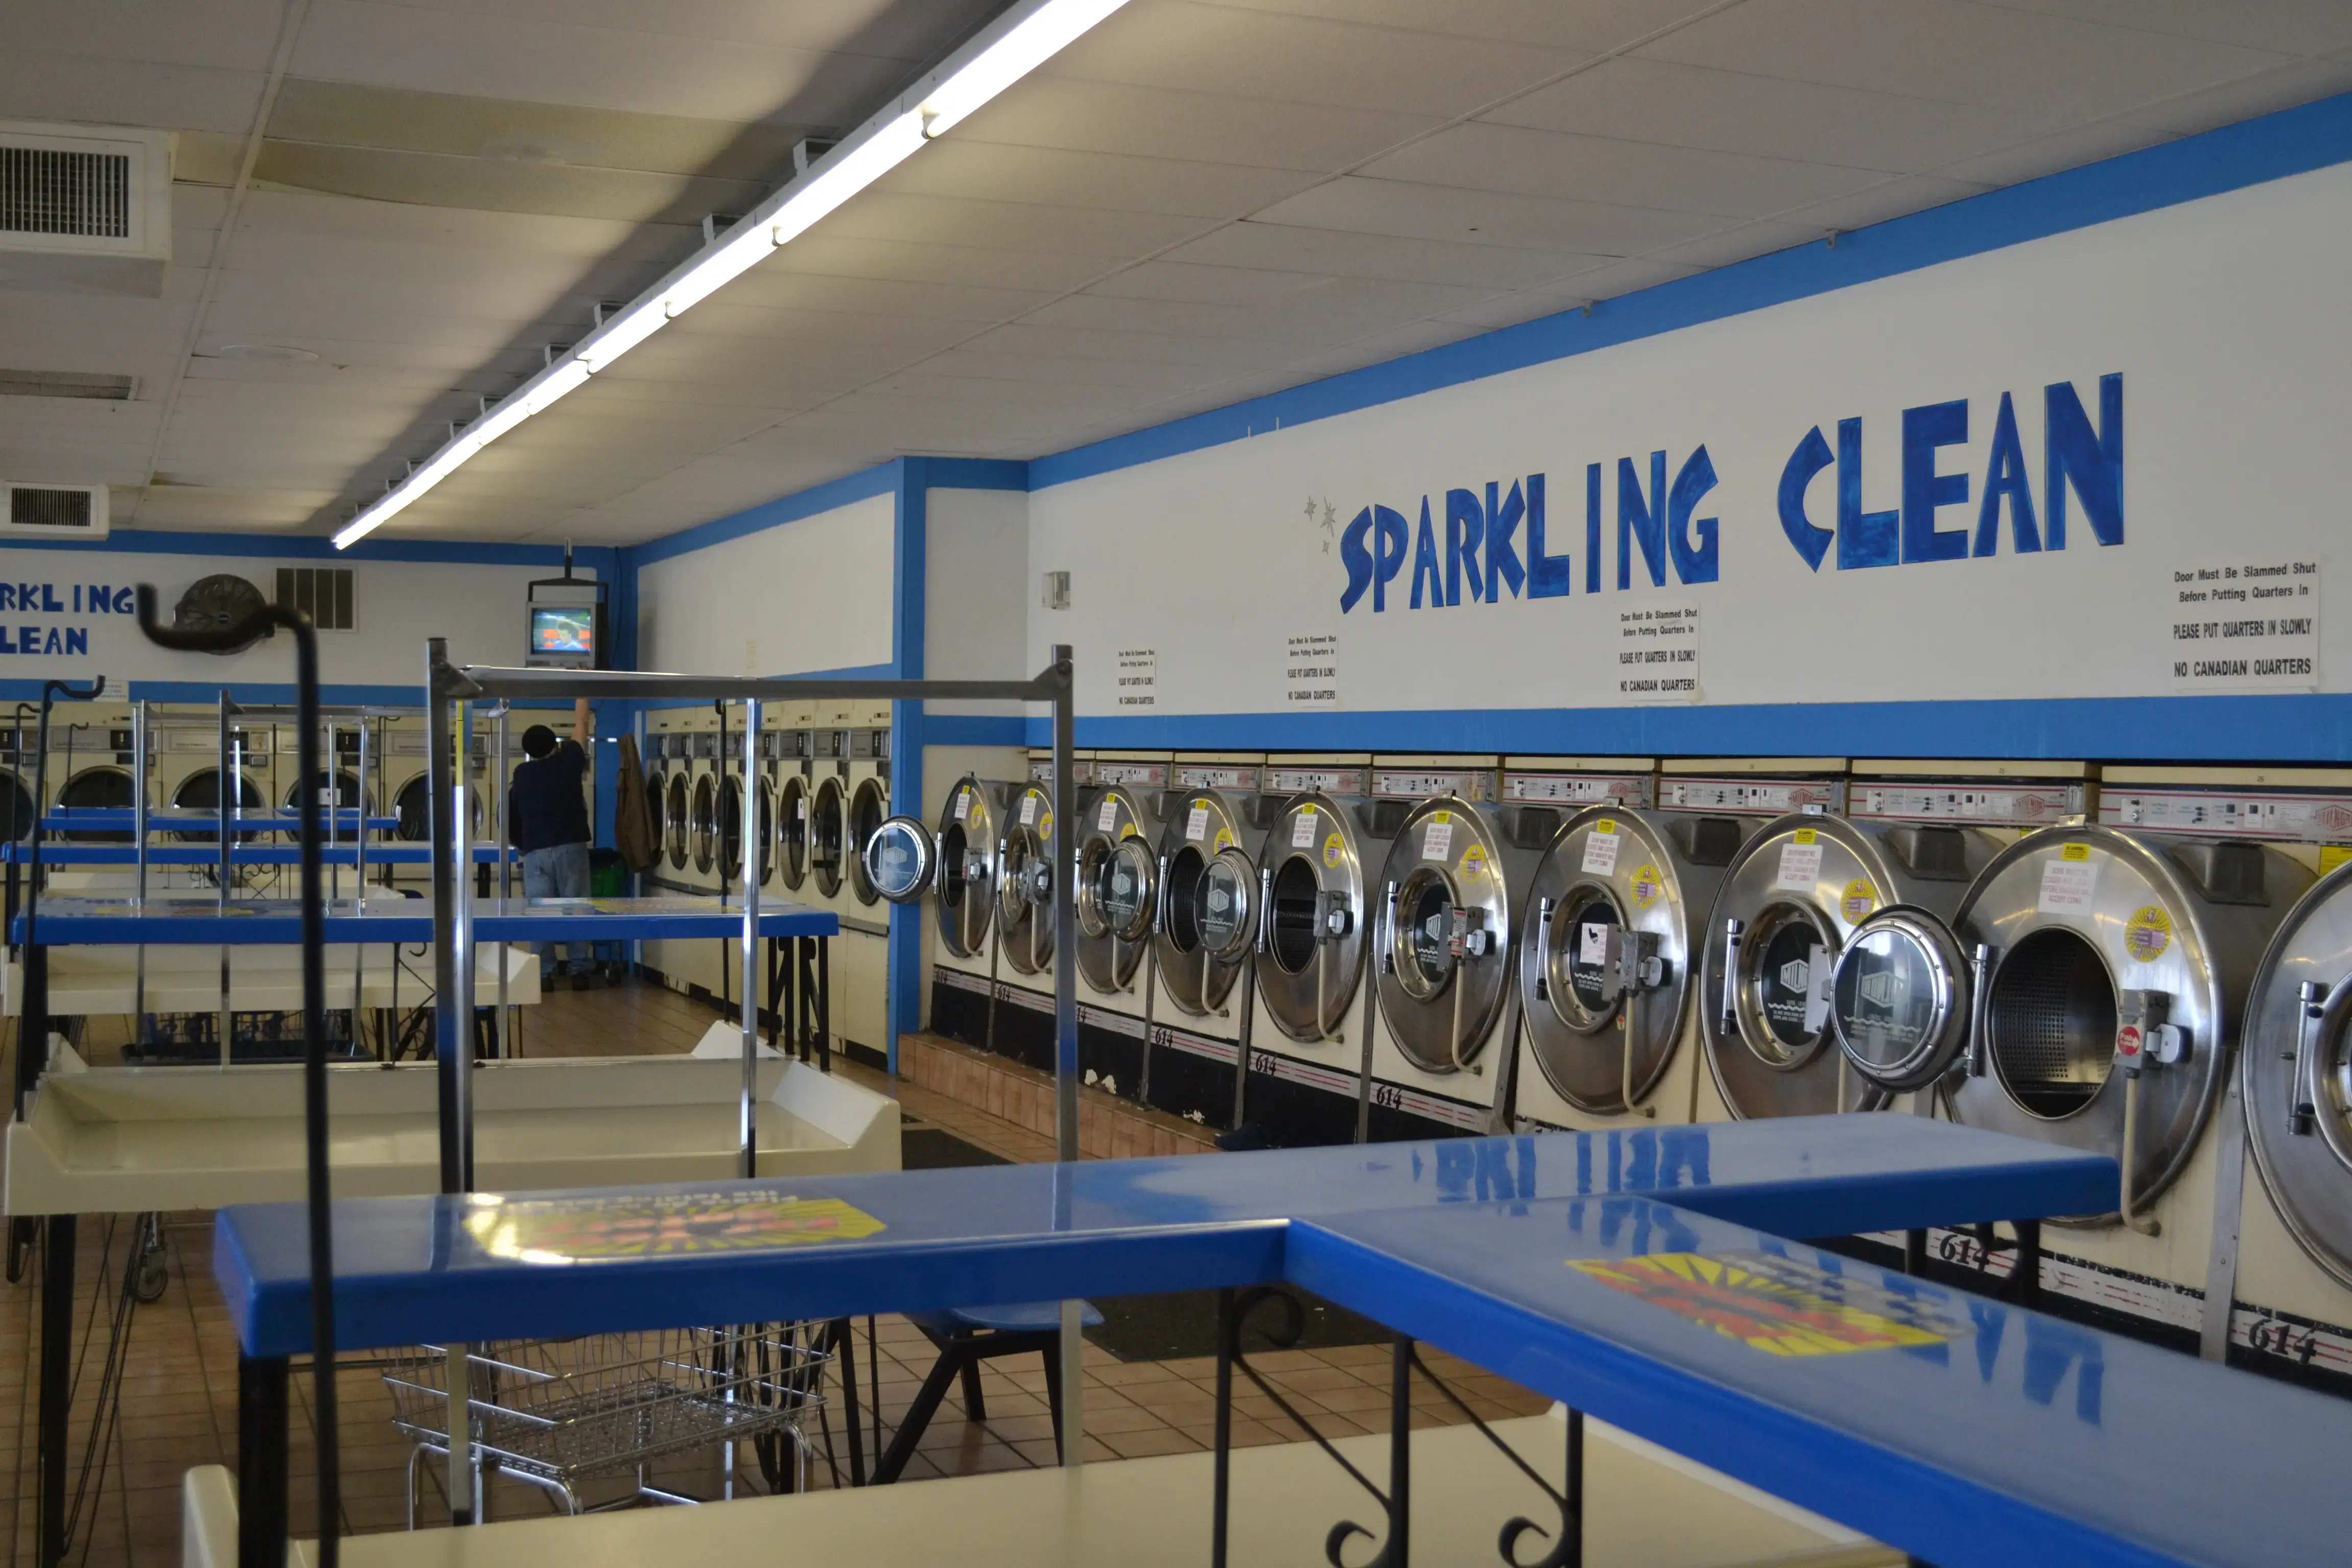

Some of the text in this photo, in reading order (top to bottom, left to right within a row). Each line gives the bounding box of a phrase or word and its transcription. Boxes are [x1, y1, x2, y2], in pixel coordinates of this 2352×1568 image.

[1340, 372, 2124, 615] SPARKLING CLEAN
[2175, 562, 2316, 582] Door Must Be Slammed Shut
[2179, 584, 2308, 602] Before Putting Quarters In
[1646, 611, 1652, 620] Be
[1655, 609, 1681, 619] Slammed
[1685, 609, 1697, 617] Shut
[1624, 625, 1694, 636] Before Putting Quarters In
[2174, 619, 2311, 639] PLEASE PUT QUARTERS IN SLOWLY
[1620, 652, 1633, 664] PLEASE
[1645, 651, 1667, 663] QUARTERS
[1670, 651, 1675, 662] IN
[1678, 650, 1695, 662] SLOWLY
[2175, 658, 2311, 677] NO CANADIAN QUARTERS
[1621, 679, 1694, 692] NO CANADIAN QUARTERS
[1288, 691, 1335, 700] NO CANADIAN QUARTERS
[1782, 962, 1808, 989] MILN
[998, 985, 1011, 1002] 614
[1076, 1006, 1086, 1022] 14
[1155, 1028, 1173, 1049] 614
[1256, 1054, 1277, 1077] 614
[1377, 1085, 1402, 1111] 614
[1940, 1234, 1990, 1271] 614
[2249, 1318, 2317, 1365] 614
